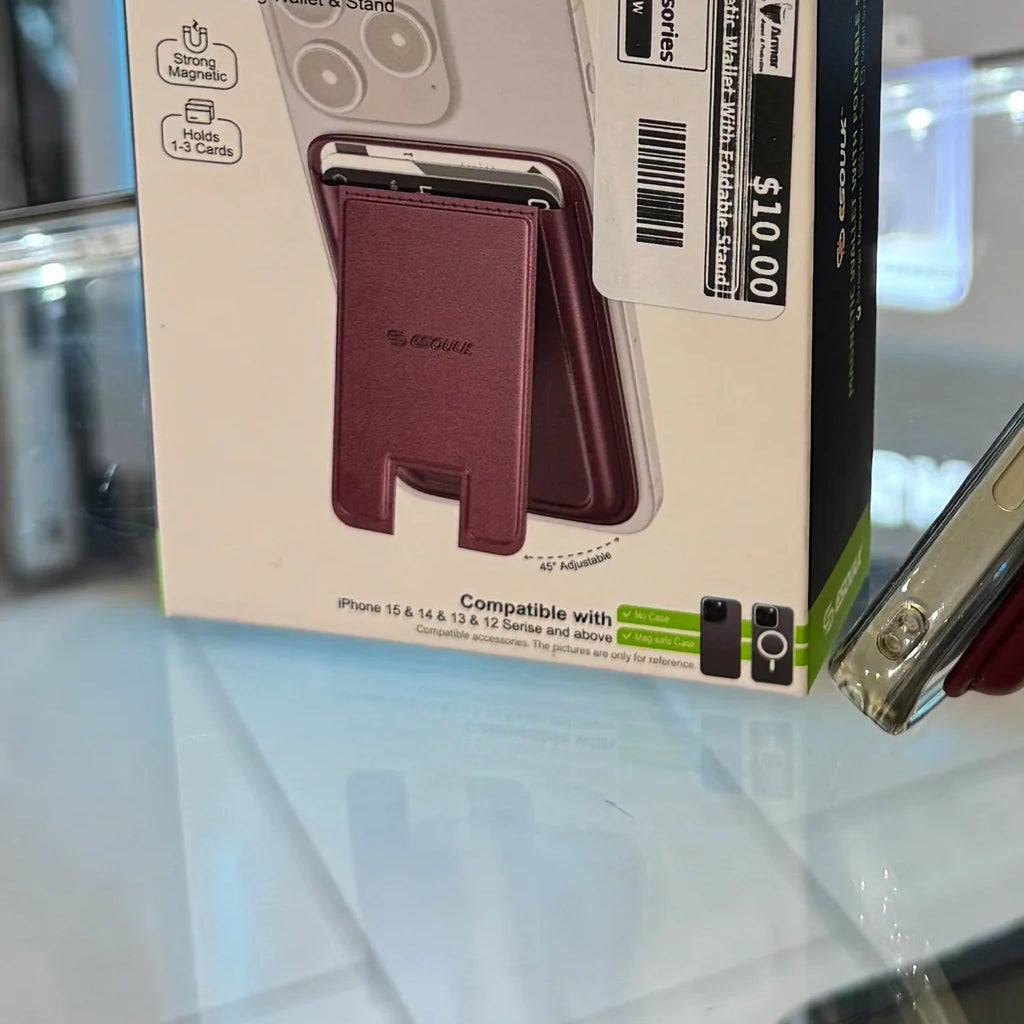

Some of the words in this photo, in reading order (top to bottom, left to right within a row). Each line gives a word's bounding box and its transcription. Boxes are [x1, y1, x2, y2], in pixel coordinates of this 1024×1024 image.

[168, 65, 228, 82] Magnetic
[174, 52, 216, 70] Strong
[721, 35, 739, 96] Wallet
[183, 128, 220, 143] Holds
[720, 100, 736, 143] With
[171, 140, 191, 153] 1-3
[195, 142, 234, 157] Cards
[718, 150, 735, 228] Foldable
[748, 176, 783, 298] $10.00
[716, 234, 732, 287] Stand
[540, 561, 557, 571] 45°
[560, 551, 612, 571] Adjustable
[338, 597, 381, 613] iPhone
[386, 604, 401, 616] 15
[405, 606, 414, 618] &
[419, 608, 433, 620] 14
[437, 610, 446, 622] &
[451, 612, 466, 624] 13
[470, 614, 479, 626] &
[484, 616, 499, 628] 12
[502, 618, 543, 635] Serise
[546, 625, 570, 638] and
[574, 628, 613, 643] above
[460, 593, 568, 621] Compatible
[573, 608, 613, 627] with
[634, 611, 647, 621] No
[648, 613, 670, 624] Case
[416, 624, 470, 640] Compatible
[472, 632, 529, 648] accessories.
[533, 640, 549, 651] The
[553, 642, 590, 657] pictures
[593, 649, 609, 658] are
[611, 650, 631, 663] only
[634, 652, 646, 663] for
[649, 656, 697, 670] reference.
